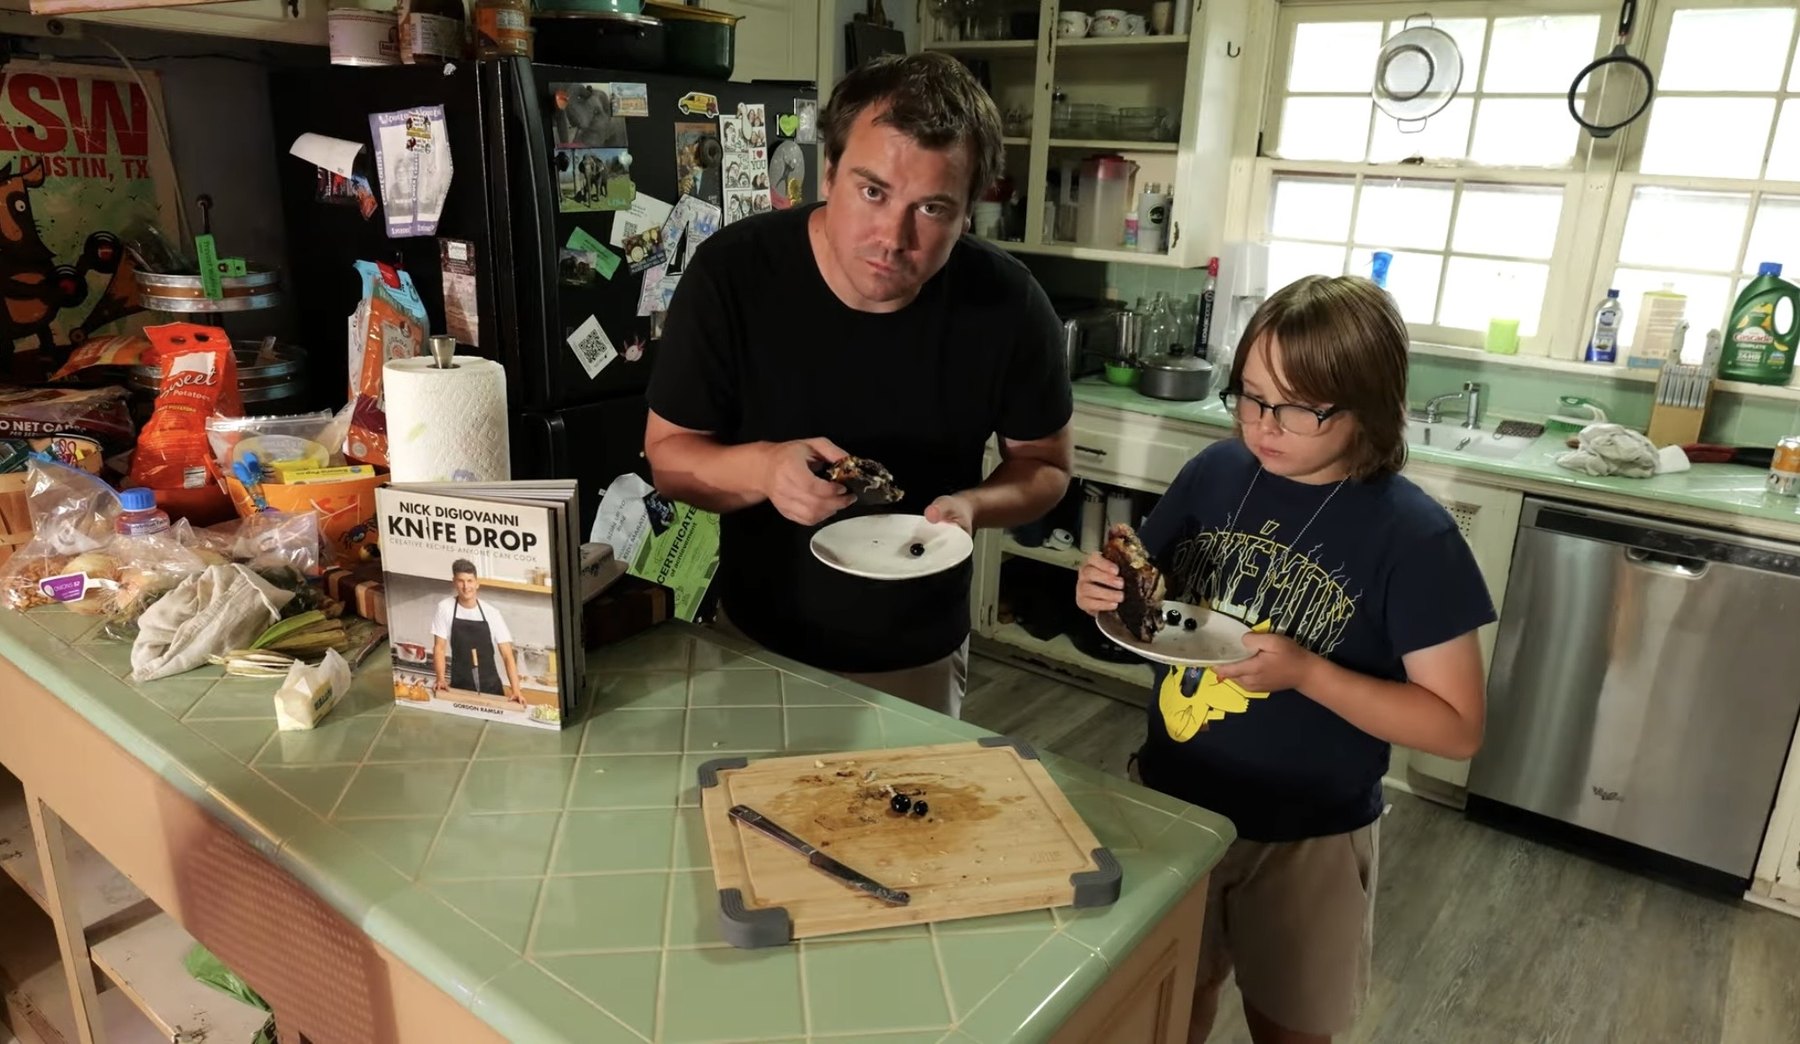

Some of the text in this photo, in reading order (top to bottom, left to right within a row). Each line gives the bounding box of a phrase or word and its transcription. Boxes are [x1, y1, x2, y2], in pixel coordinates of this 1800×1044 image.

[0, 72, 148, 156] SW
[121, 159, 149, 179] TX
[750, 159, 766, 170] YOU
[1734, 333, 1773, 343] Cascade
[13, 421, 40, 432] NET
[399, 501, 519, 527] NICK DIGIOVANNI
[388, 514, 537, 552] KNIFE DROP
[656, 506, 698, 585] CERTIFICATE
[674, 522, 698, 569] achievement
[389, 537, 422, 549] CREATIVE
[426, 541, 455, 553] RECIPES
[493, 550, 511, 560] CAN
[513, 552, 537, 563] COOK
[453, 702, 504, 715] GORDON RAMSAY
